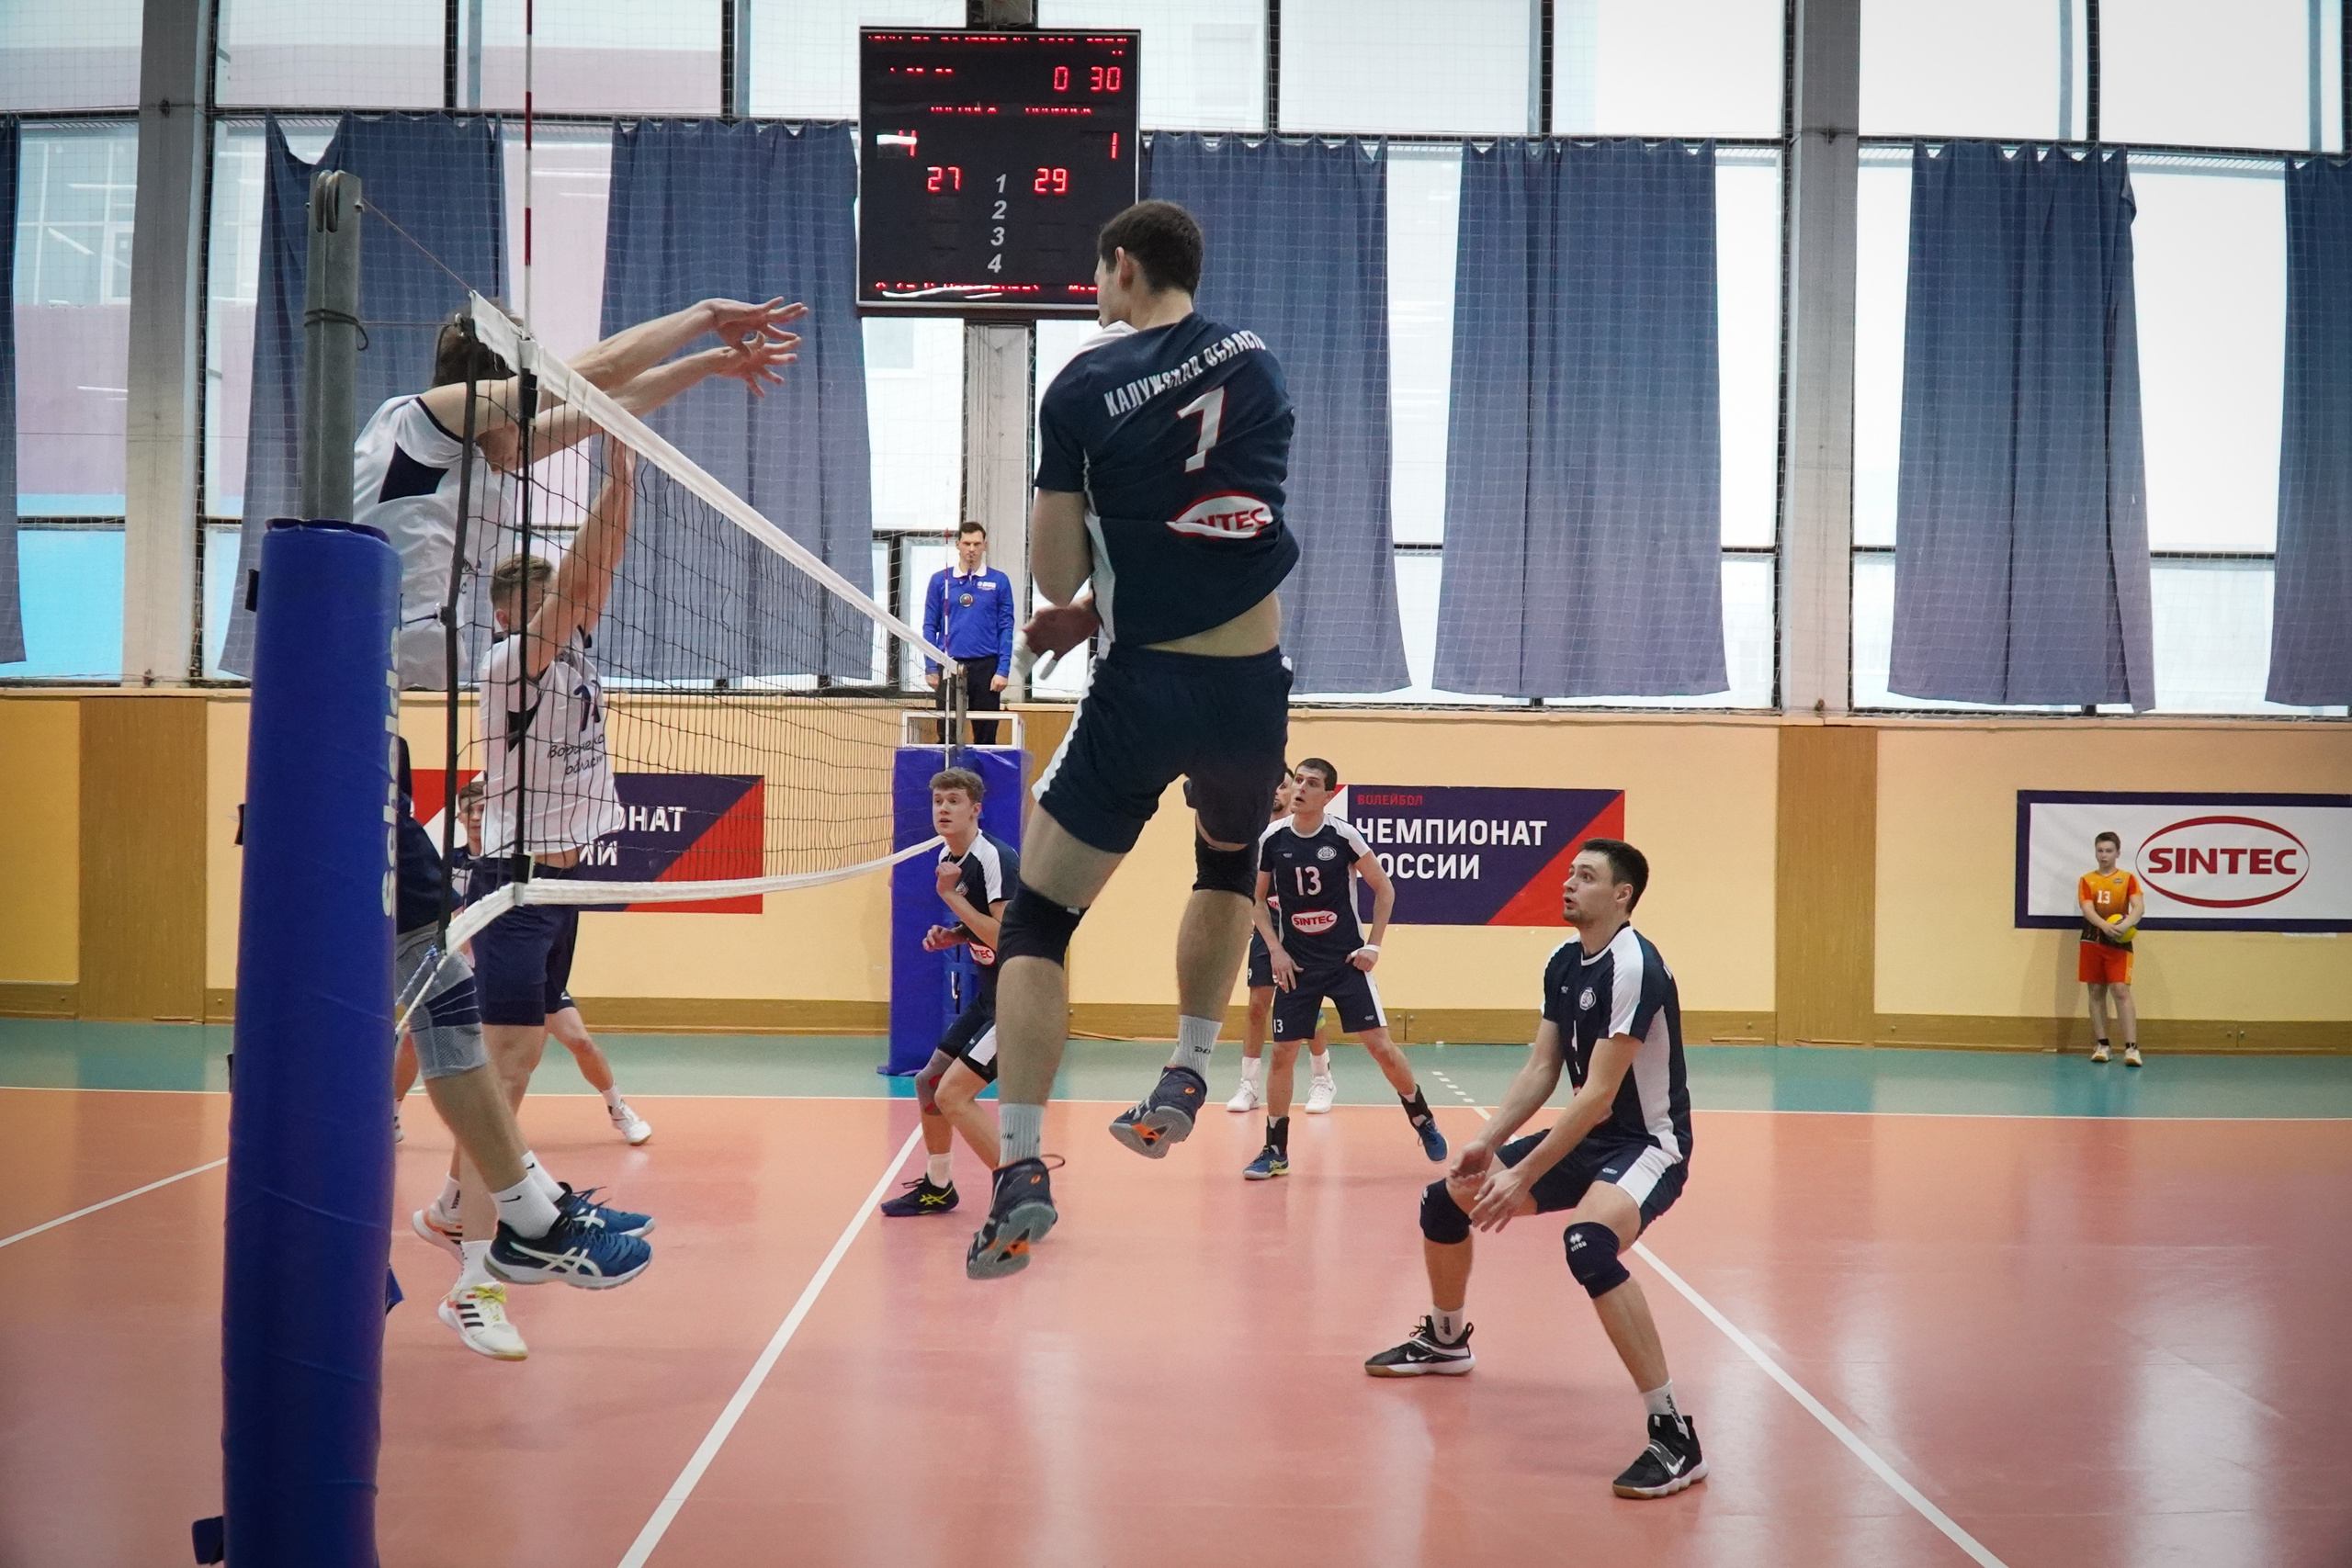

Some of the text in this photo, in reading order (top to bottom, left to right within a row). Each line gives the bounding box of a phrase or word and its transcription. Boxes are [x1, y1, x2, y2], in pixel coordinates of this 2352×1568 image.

[1054, 66, 1121, 91] 0 30
[927, 166, 960, 192] 27
[995, 174, 1007, 193] 1
[1035, 167, 1068, 193] 29
[991, 200, 1007, 220] 2
[990, 227, 1004, 245] 3
[988, 254, 1002, 273] 4
[1177, 385, 1226, 474] 7
[1357, 794, 1423, 806] ВОЛЕЙБОЛ
[1356, 818, 1547, 846] ЧЕМПИОНАТ
[1376, 853, 1480, 879] ОССИИ
[2148, 848, 2297, 874] SINTEC
[1295, 866, 1322, 896] 13
[2097, 889, 2110, 904] 13
[1294, 914, 1334, 926] SINTEC
[1273, 1019, 1283, 1033] 13
